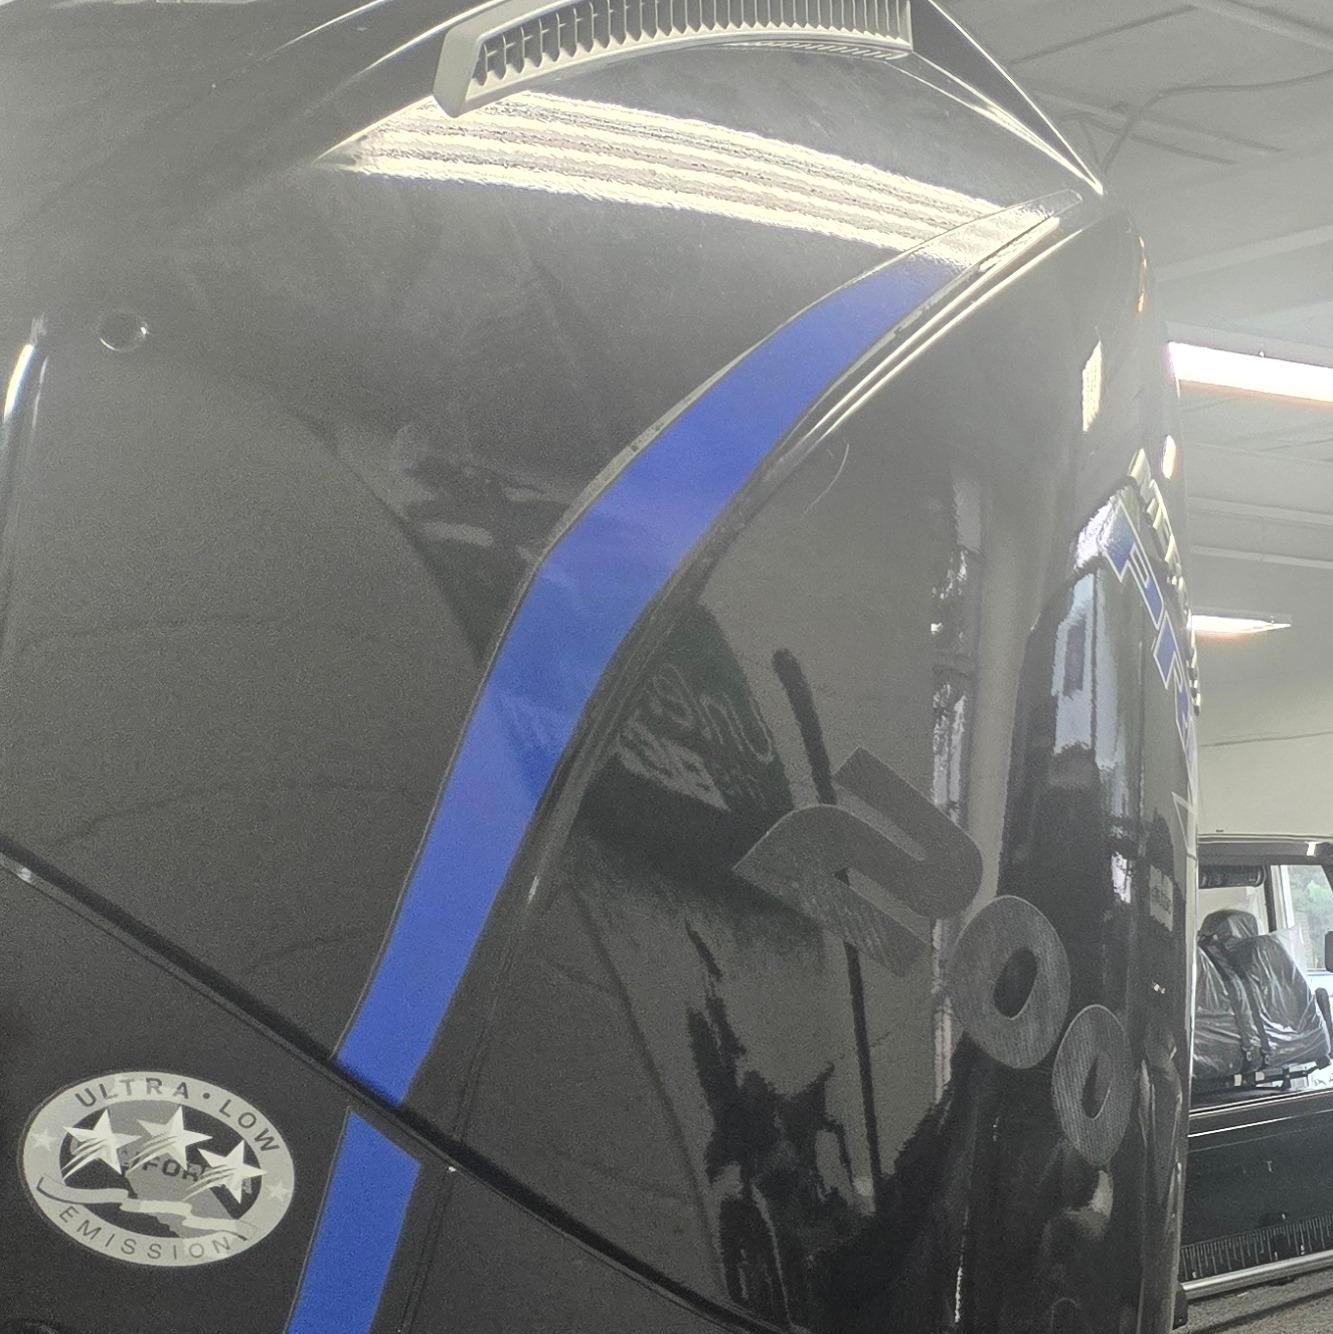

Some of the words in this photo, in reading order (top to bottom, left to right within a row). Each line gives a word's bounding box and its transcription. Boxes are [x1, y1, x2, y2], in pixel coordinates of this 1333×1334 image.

[732, 745, 1132, 1172] 200
[75, 1077, 189, 1108] ULTRA
[218, 1099, 281, 1153] LOW
[59, 1205, 231, 1260] EMISSION
